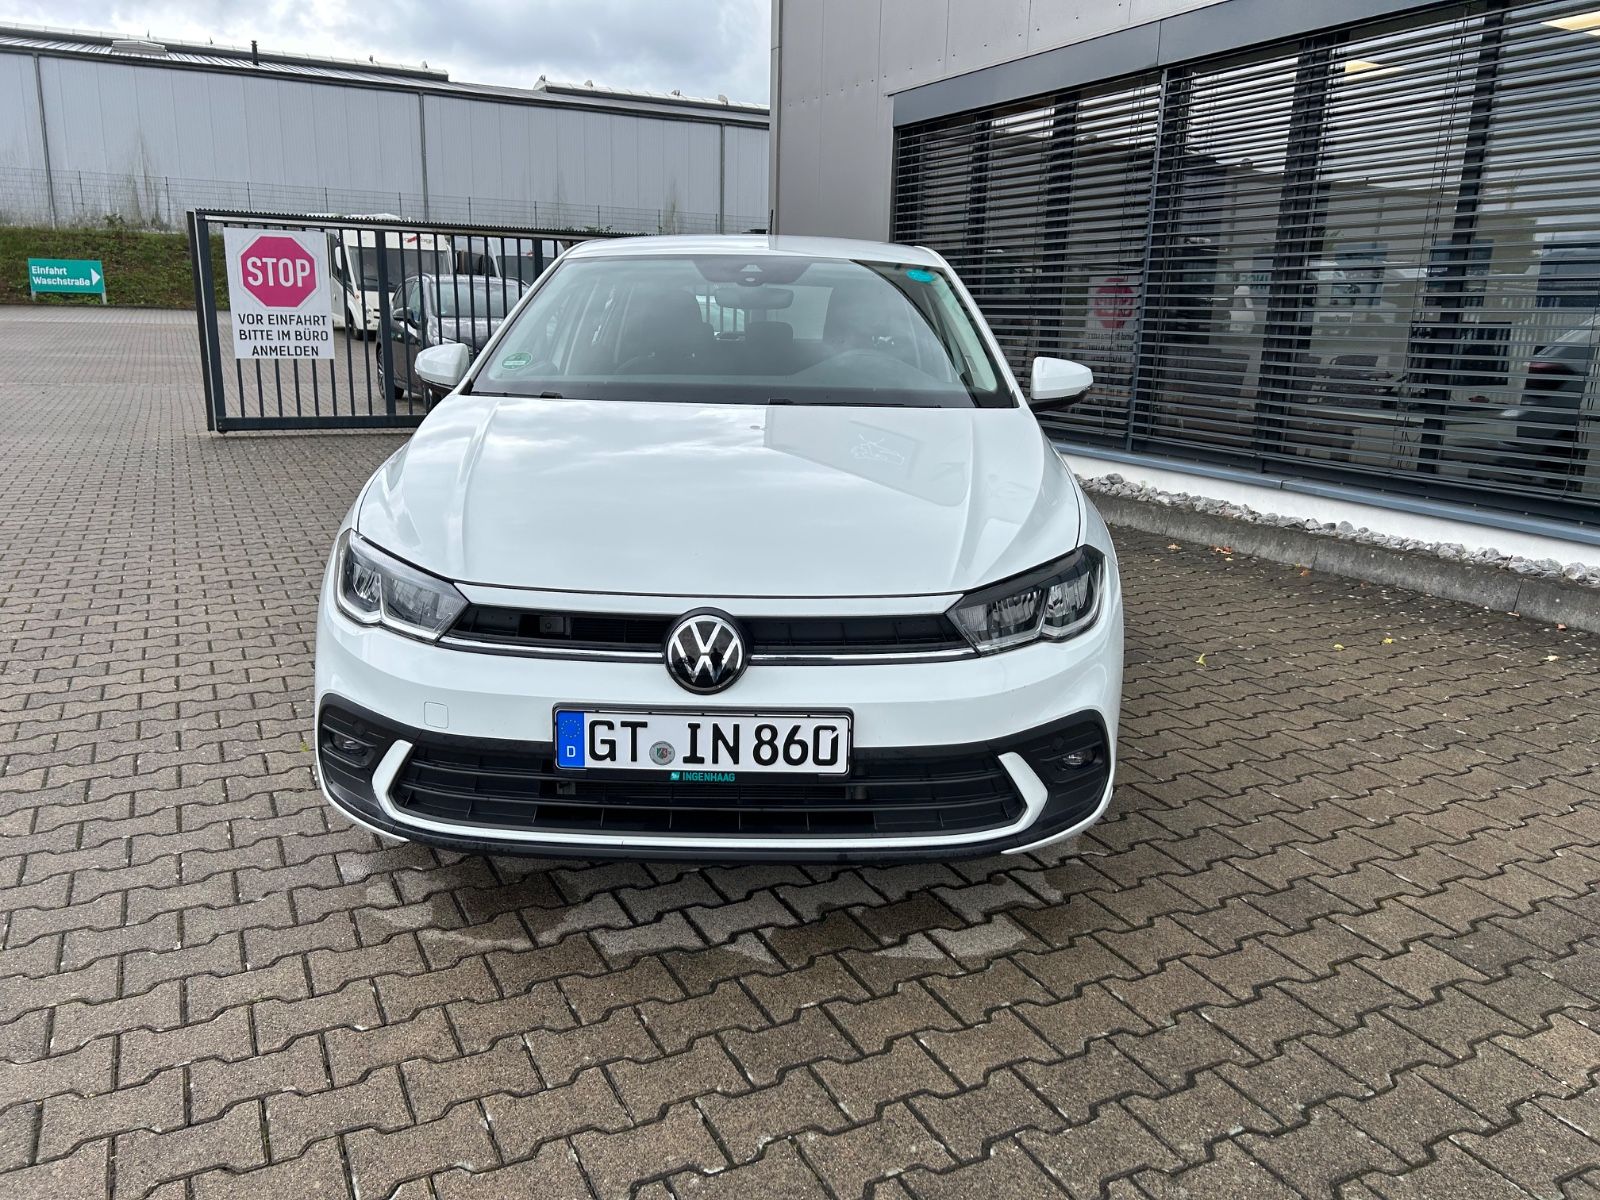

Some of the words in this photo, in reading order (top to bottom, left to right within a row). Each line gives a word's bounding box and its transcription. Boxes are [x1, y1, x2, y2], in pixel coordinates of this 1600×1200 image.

[31, 265, 68, 275] Einfahrt
[246, 256, 311, 288] STOP
[32, 276, 91, 286] Waschstraße
[238, 313, 264, 325] VOR
[268, 314, 327, 326] EINFAHRT
[239, 329, 273, 341] BITTE
[277, 330, 291, 341] IM
[295, 328, 329, 341] BÜRO
[252, 345, 319, 357] ANMELDEN
[668, 615, 743, 691] VW
[588, 719, 648, 762] GT
[682, 722, 740, 765] IN
[752, 723, 839, 766] 860
[566, 745, 576, 757] D
[682, 771, 736, 782] INGENHAAG
